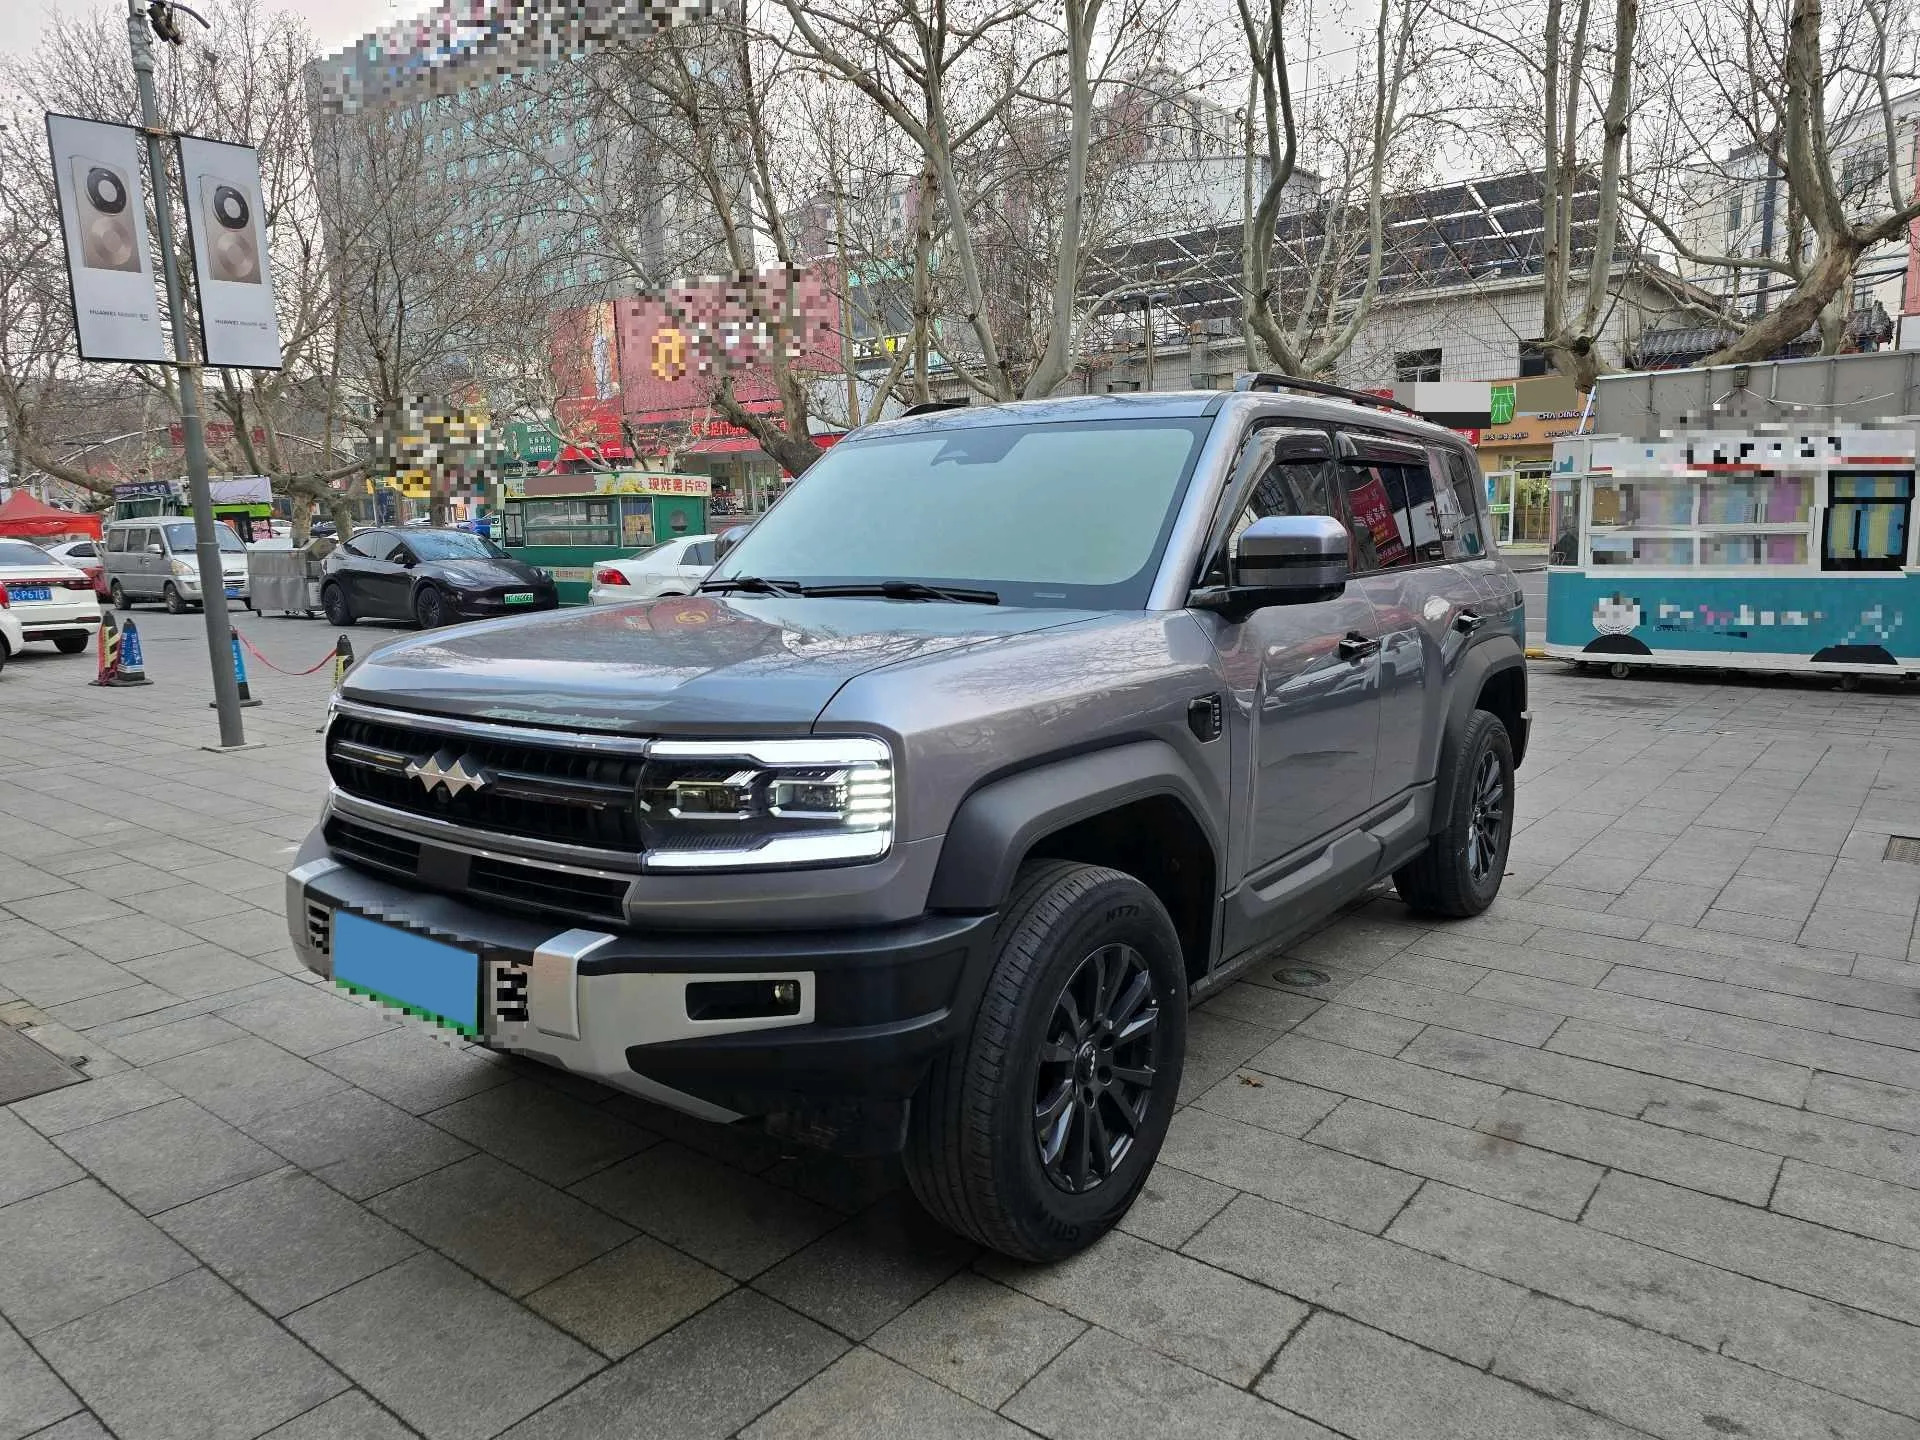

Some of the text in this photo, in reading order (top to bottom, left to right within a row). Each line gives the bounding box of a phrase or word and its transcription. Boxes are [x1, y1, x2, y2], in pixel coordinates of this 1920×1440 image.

[89, 308, 117, 317] HUAWEI
[214, 318, 240, 327] HUAWEI
[1557, 409, 1580, 420] DING
